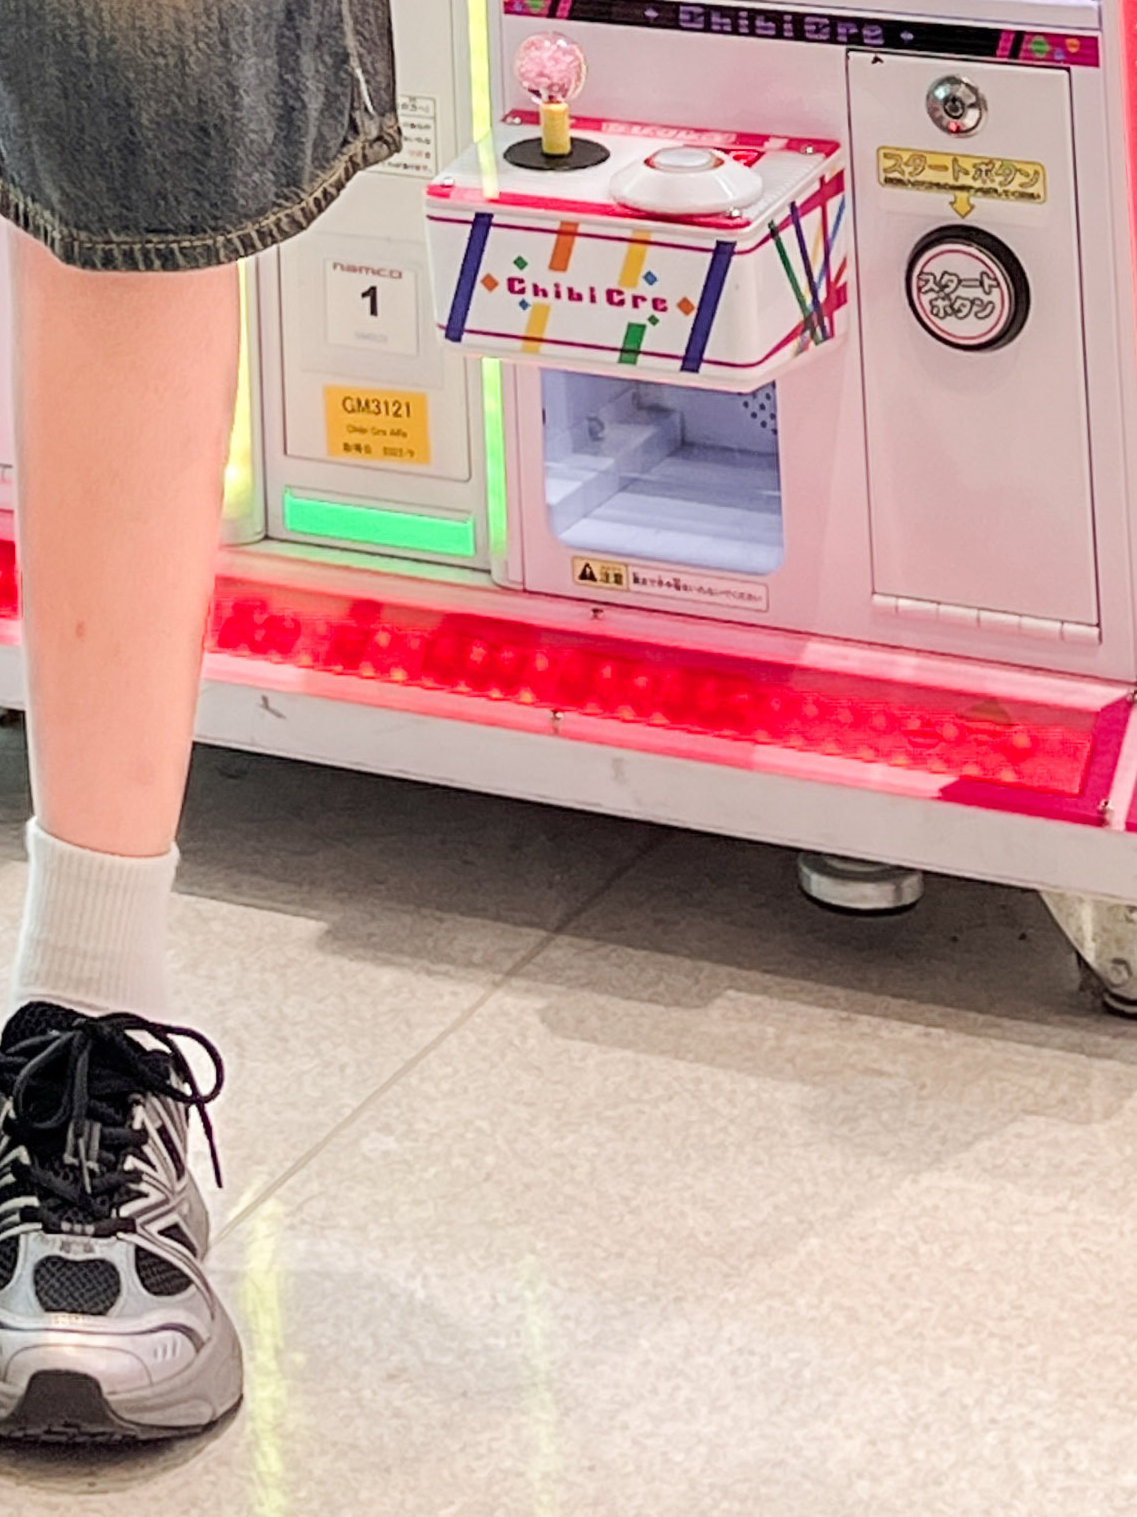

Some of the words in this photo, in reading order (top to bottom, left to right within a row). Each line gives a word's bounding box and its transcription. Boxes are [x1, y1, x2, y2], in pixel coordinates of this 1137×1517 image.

[883, 152, 1041, 188] スタートボタン
[332, 262, 403, 279] namco
[918, 270, 1001, 295] スタート
[361, 285, 378, 317] 1
[929, 294, 996, 320] ボタン
[341, 395, 412, 419] GM3121
